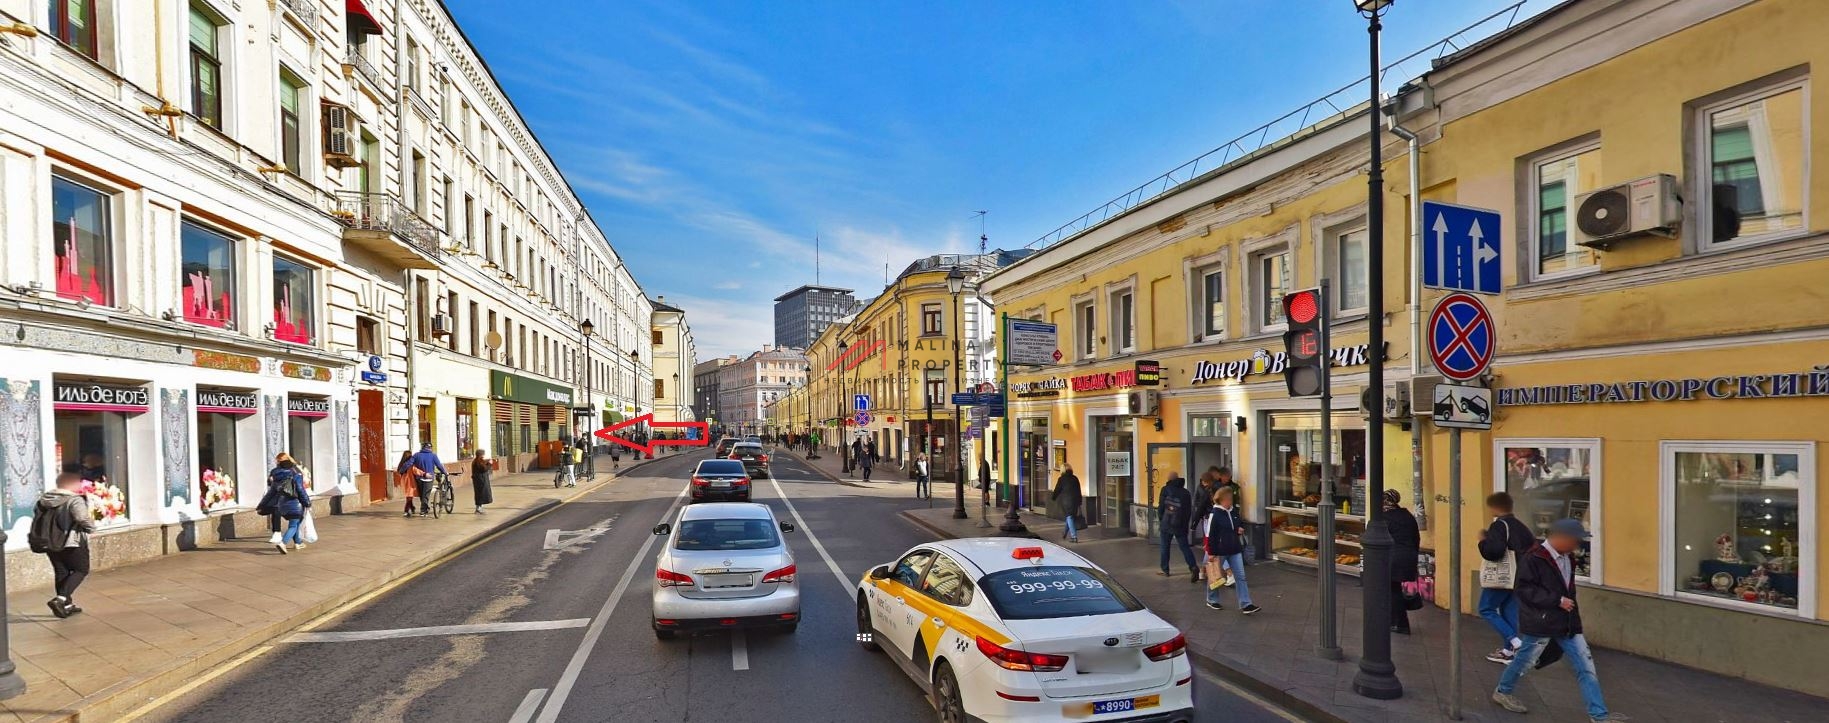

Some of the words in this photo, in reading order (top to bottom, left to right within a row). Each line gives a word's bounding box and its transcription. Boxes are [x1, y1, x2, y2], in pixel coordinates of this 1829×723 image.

[1191, 359, 1249, 385] Донер
[1071, 373, 1106, 392] ТАБАК
[1115, 369, 1136, 389] ПИ
[1497, 365, 1829, 406] ИМПЕРАТОРСКИЙ
[59, 386, 88, 402] ИЛЬ
[199, 393, 218, 405] ИЛЬ
[289, 400, 303, 410] ИЛЬ
[1010, 579, 1103, 594] 999-99-99
